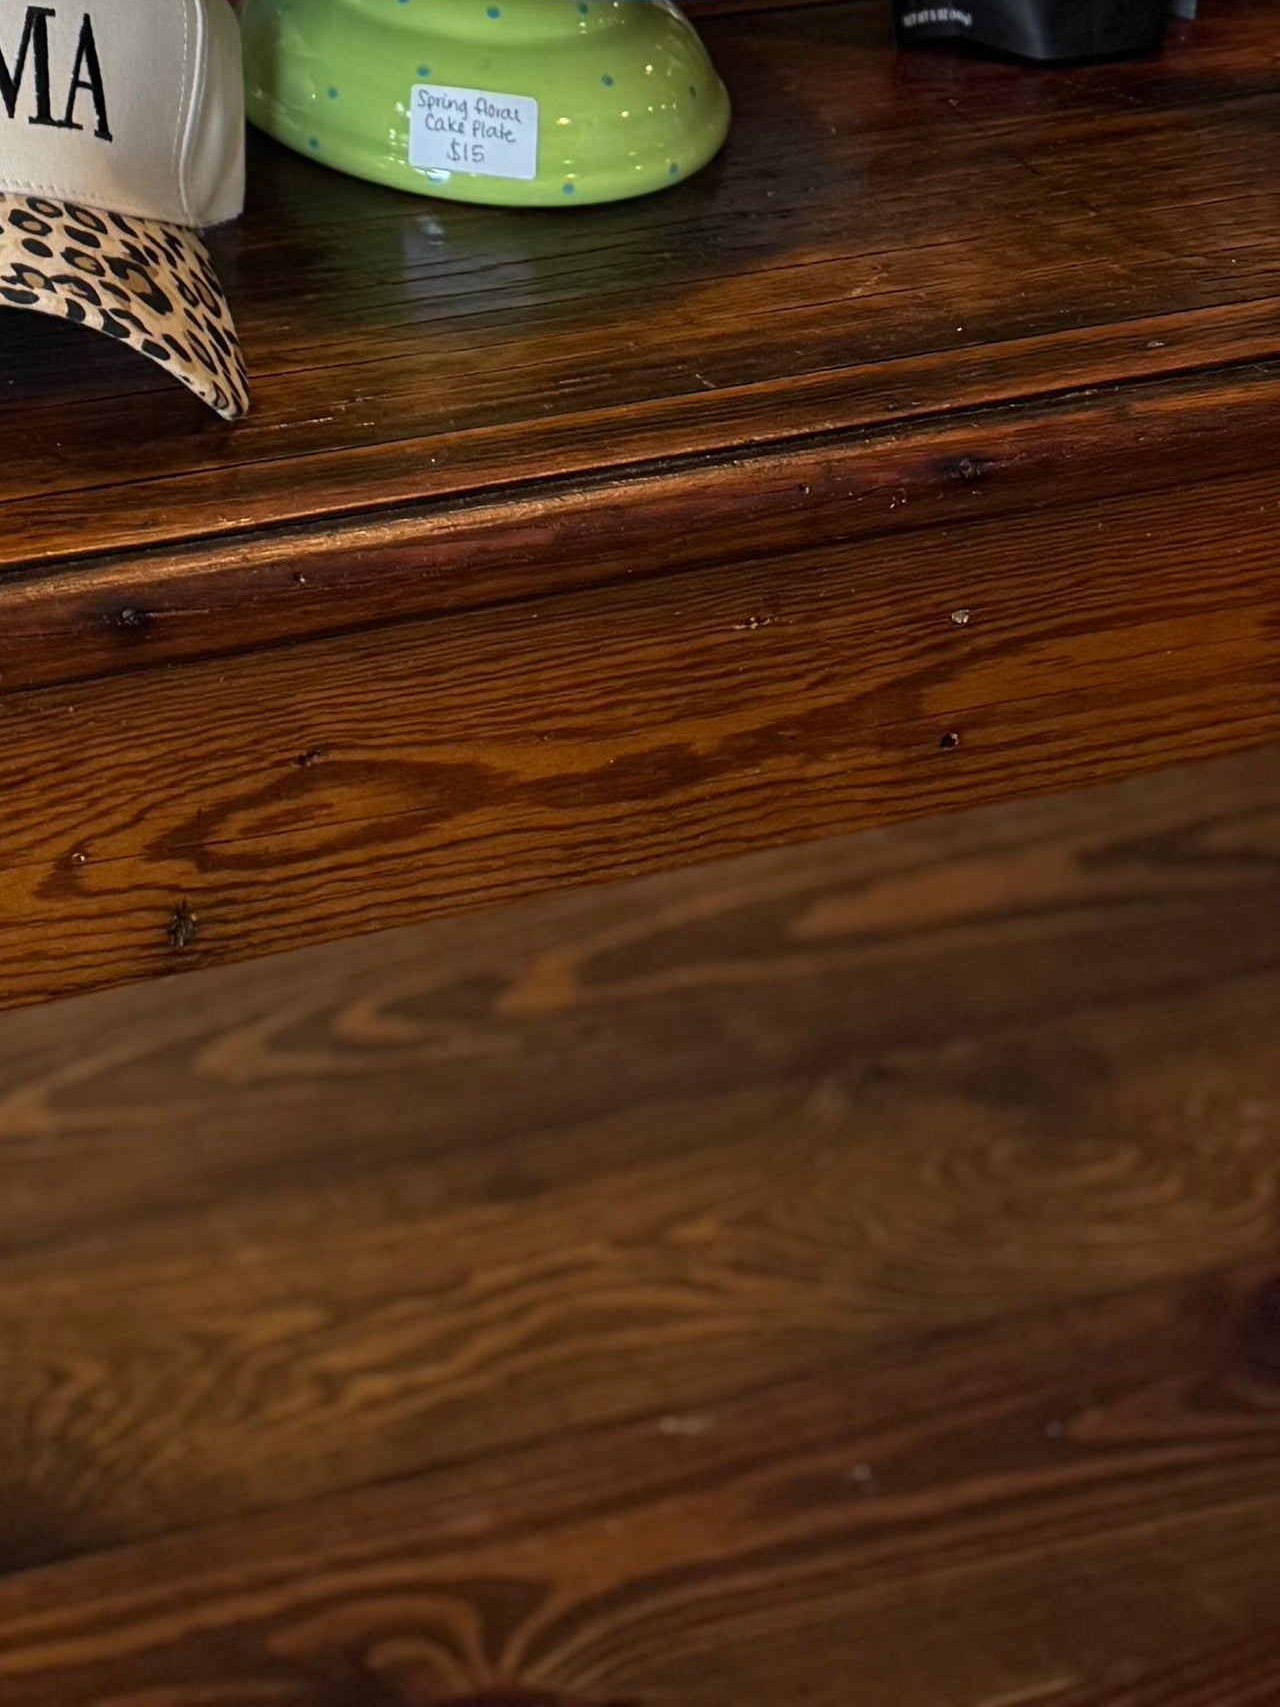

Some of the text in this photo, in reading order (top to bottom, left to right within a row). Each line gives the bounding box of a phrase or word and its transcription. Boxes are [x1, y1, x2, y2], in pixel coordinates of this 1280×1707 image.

[416, 88, 469, 120] Spring
[424, 112, 517, 144] Cake Plate
[446, 138, 486, 163] $15
